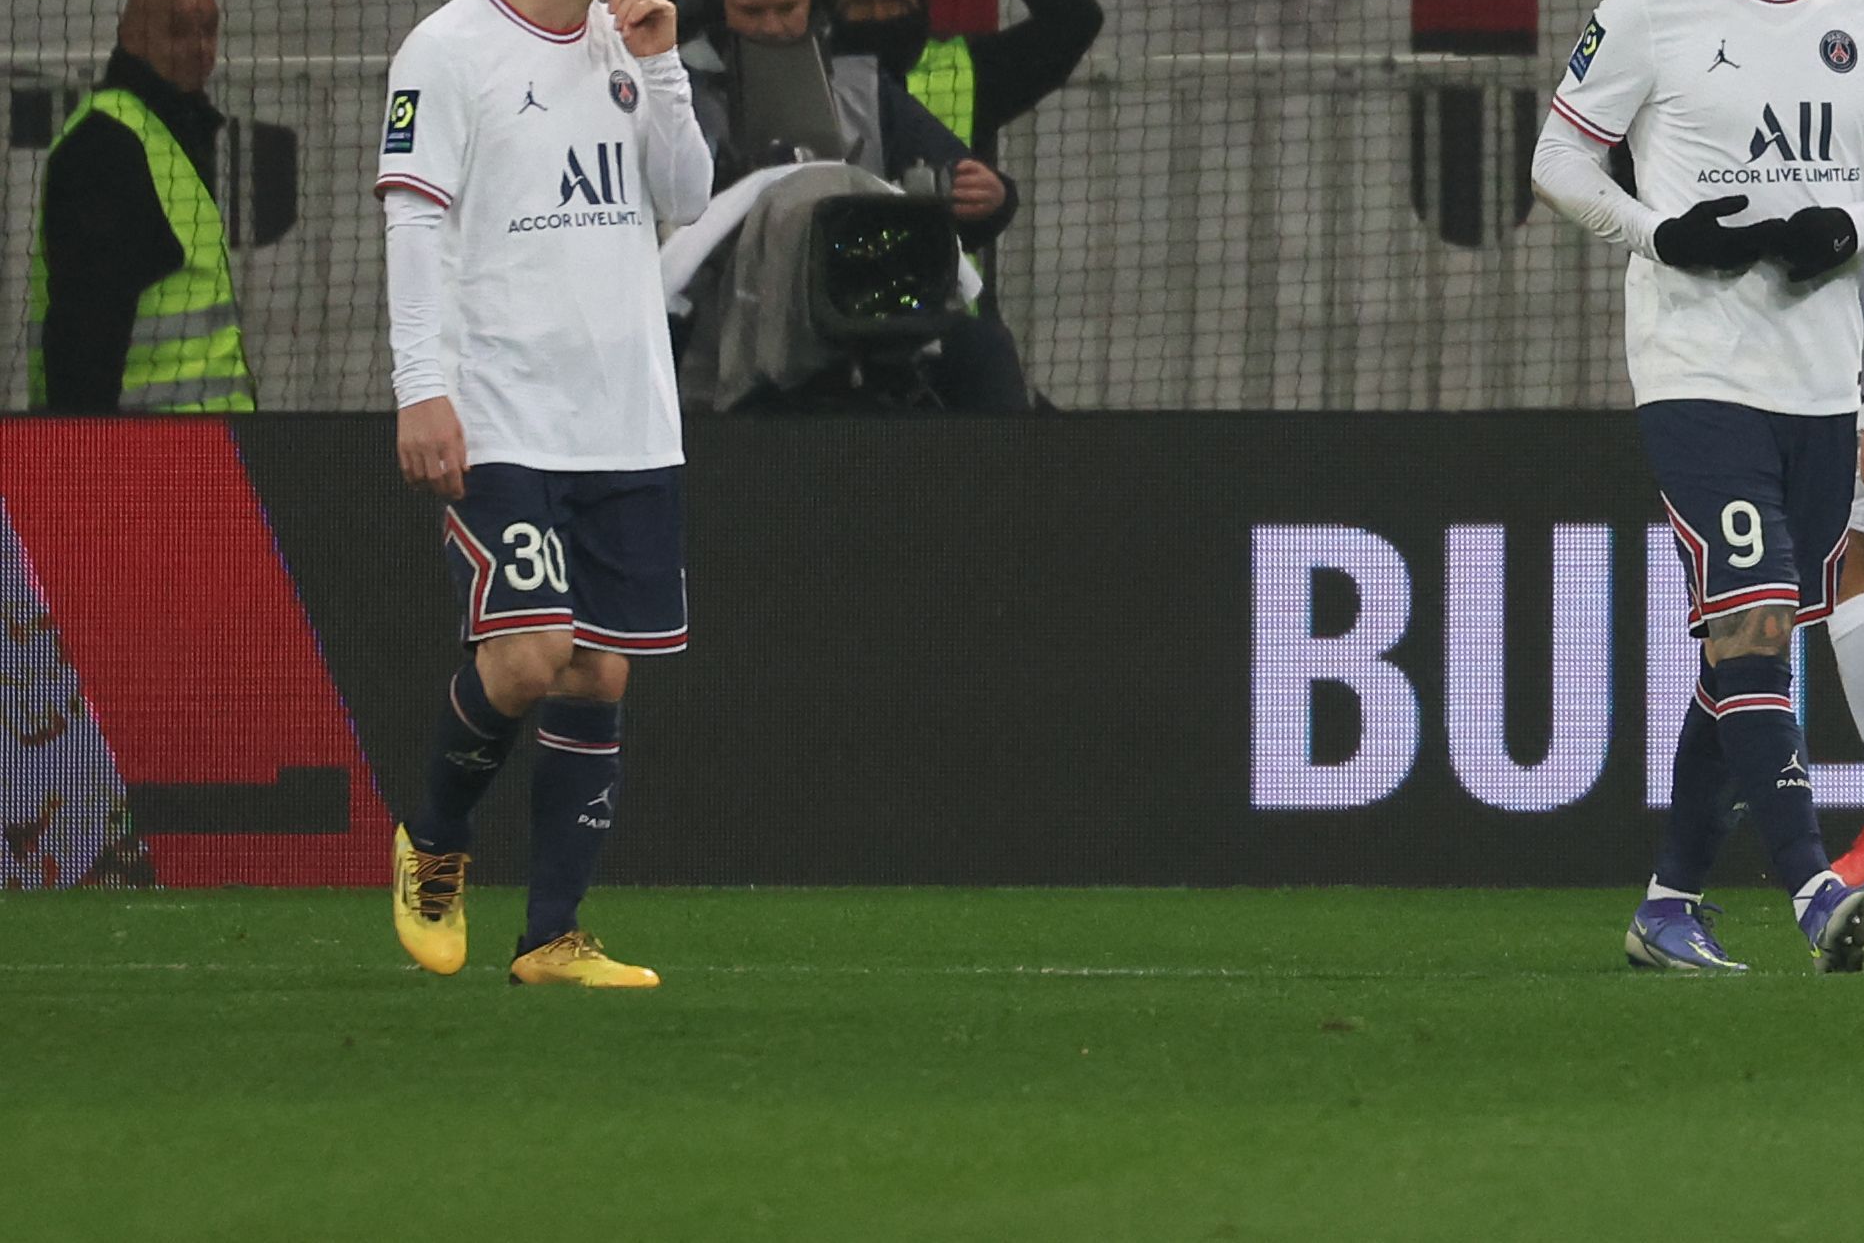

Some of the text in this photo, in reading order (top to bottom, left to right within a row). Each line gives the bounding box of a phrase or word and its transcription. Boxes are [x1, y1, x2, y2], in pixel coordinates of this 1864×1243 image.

[1697, 169, 1763, 184] ACCOR
[1766, 167, 1803, 183] LIVE
[507, 213, 572, 234] ACCOR
[1721, 500, 1764, 568] 9
[502, 521, 570, 594] 30
